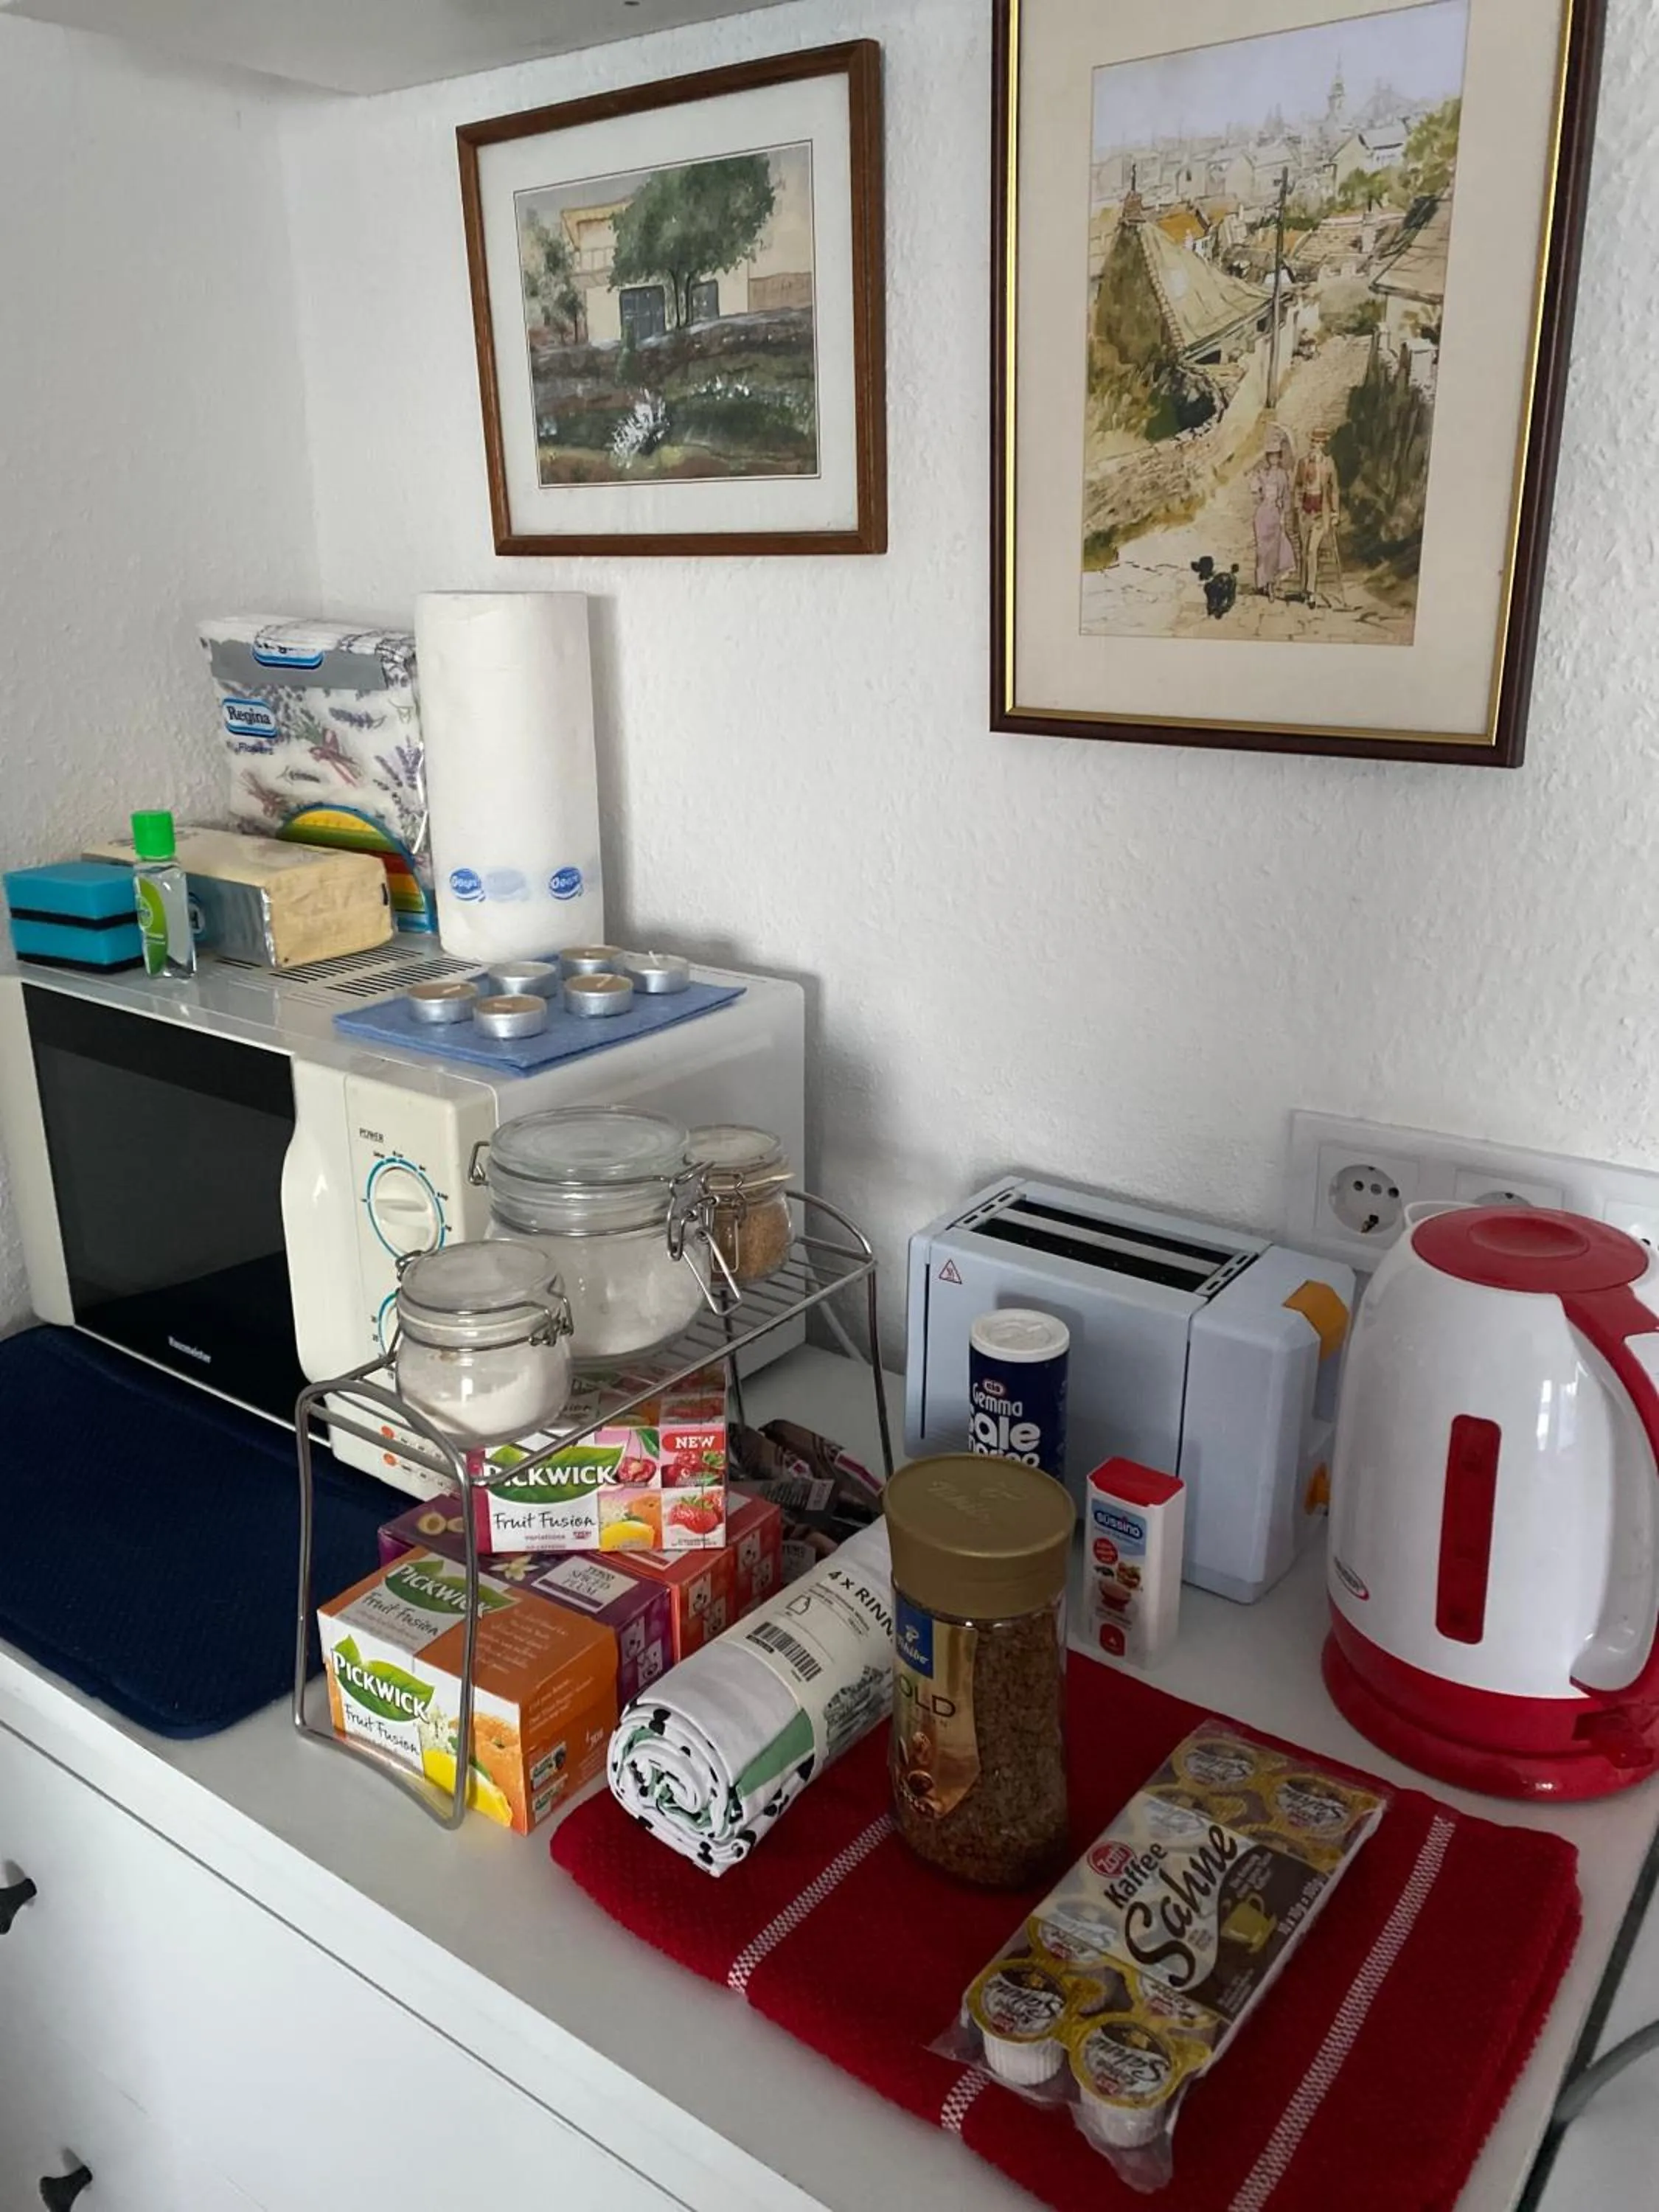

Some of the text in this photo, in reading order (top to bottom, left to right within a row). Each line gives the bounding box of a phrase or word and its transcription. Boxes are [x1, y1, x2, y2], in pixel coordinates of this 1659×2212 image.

[227, 706, 271, 725] Regina
[675, 1436, 715, 1450] NEW
[969, 1404, 1041, 1452] ale
[476, 1461, 617, 1486] PCKWICK
[493, 1511, 596, 1530] Fruit Fusion
[362, 1591, 398, 1614] Fruit
[396, 1606, 439, 1637] Fusion
[855, 1587, 894, 1643] RINN
[333, 1651, 430, 1724] PICKWICK
[344, 1703, 420, 1757] Fruit Fusion
[1103, 1842, 1168, 1910] Kaffee
[1124, 1825, 1238, 1987] Sahne
